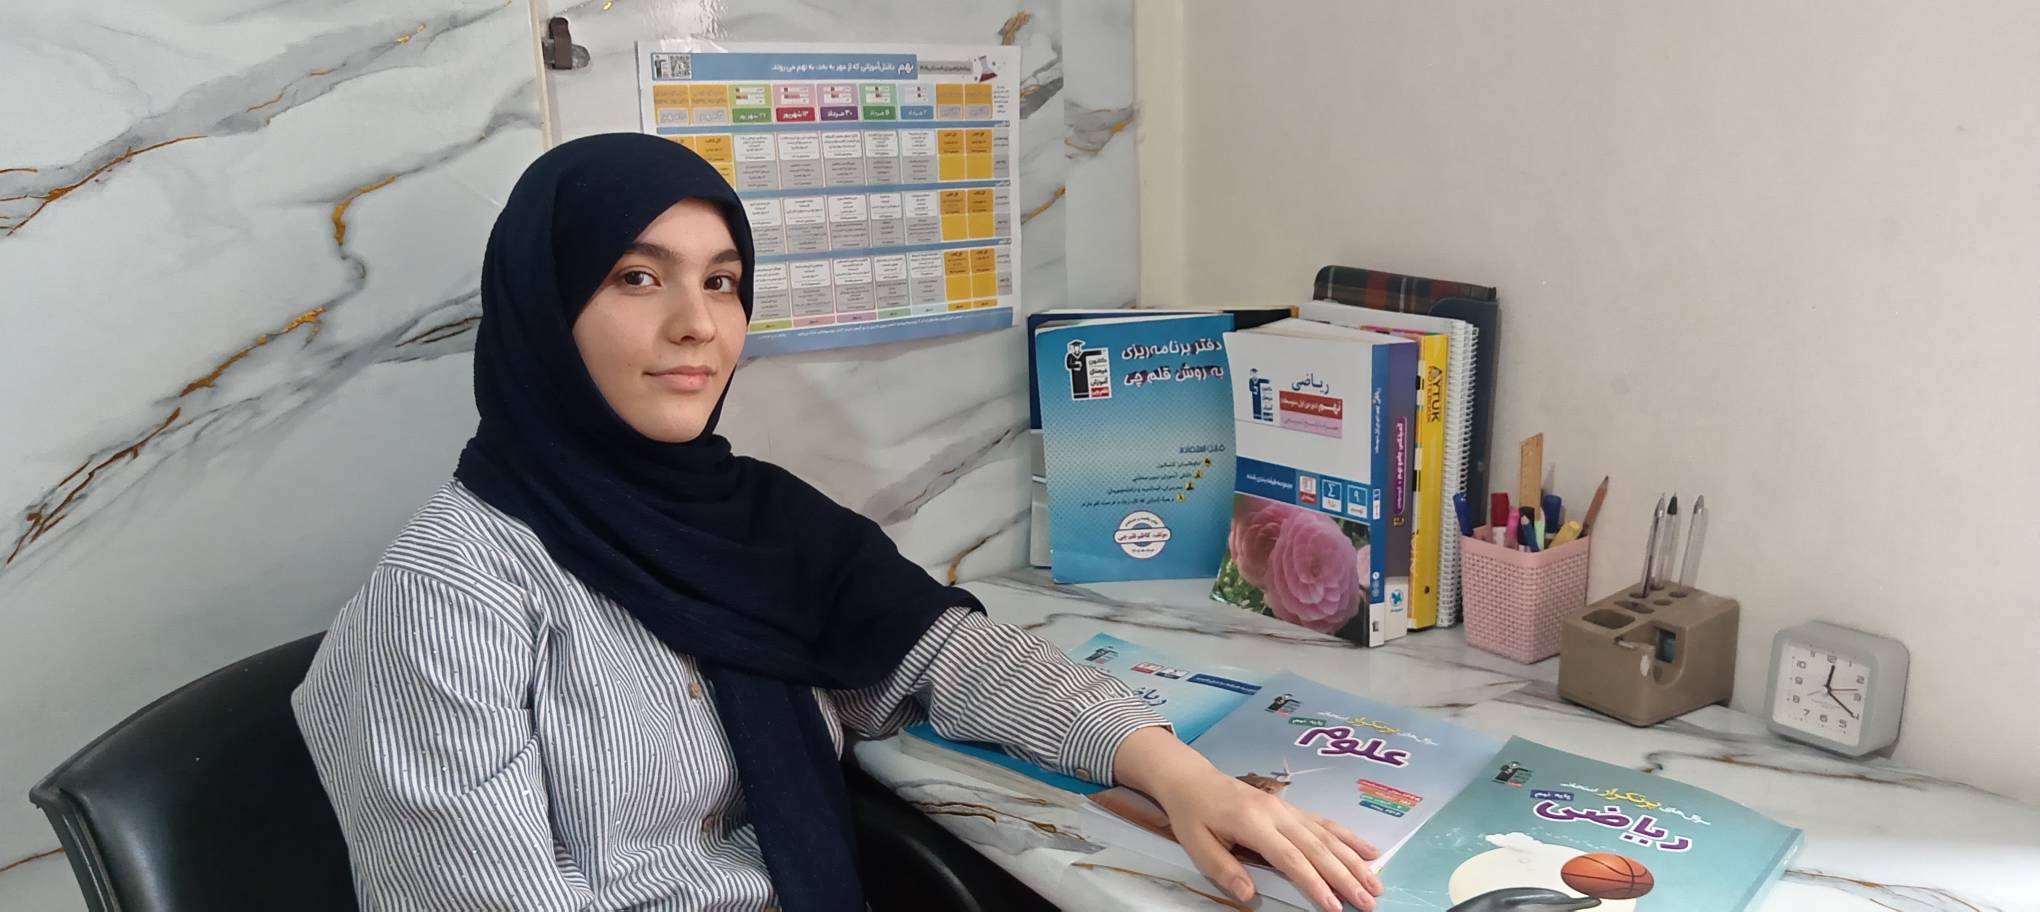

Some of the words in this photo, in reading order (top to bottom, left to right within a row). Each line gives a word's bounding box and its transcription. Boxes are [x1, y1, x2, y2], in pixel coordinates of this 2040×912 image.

[1195, 338, 1223, 355] دفتر
[1175, 364, 1207, 382] روش
[1210, 366, 1224, 380] به
[1291, 372, 1330, 395] ریاضی
[1431, 365, 1443, 423] AYTUK
[1297, 727, 1408, 767] علوم
[1534, 801, 1691, 852] ریاضی
